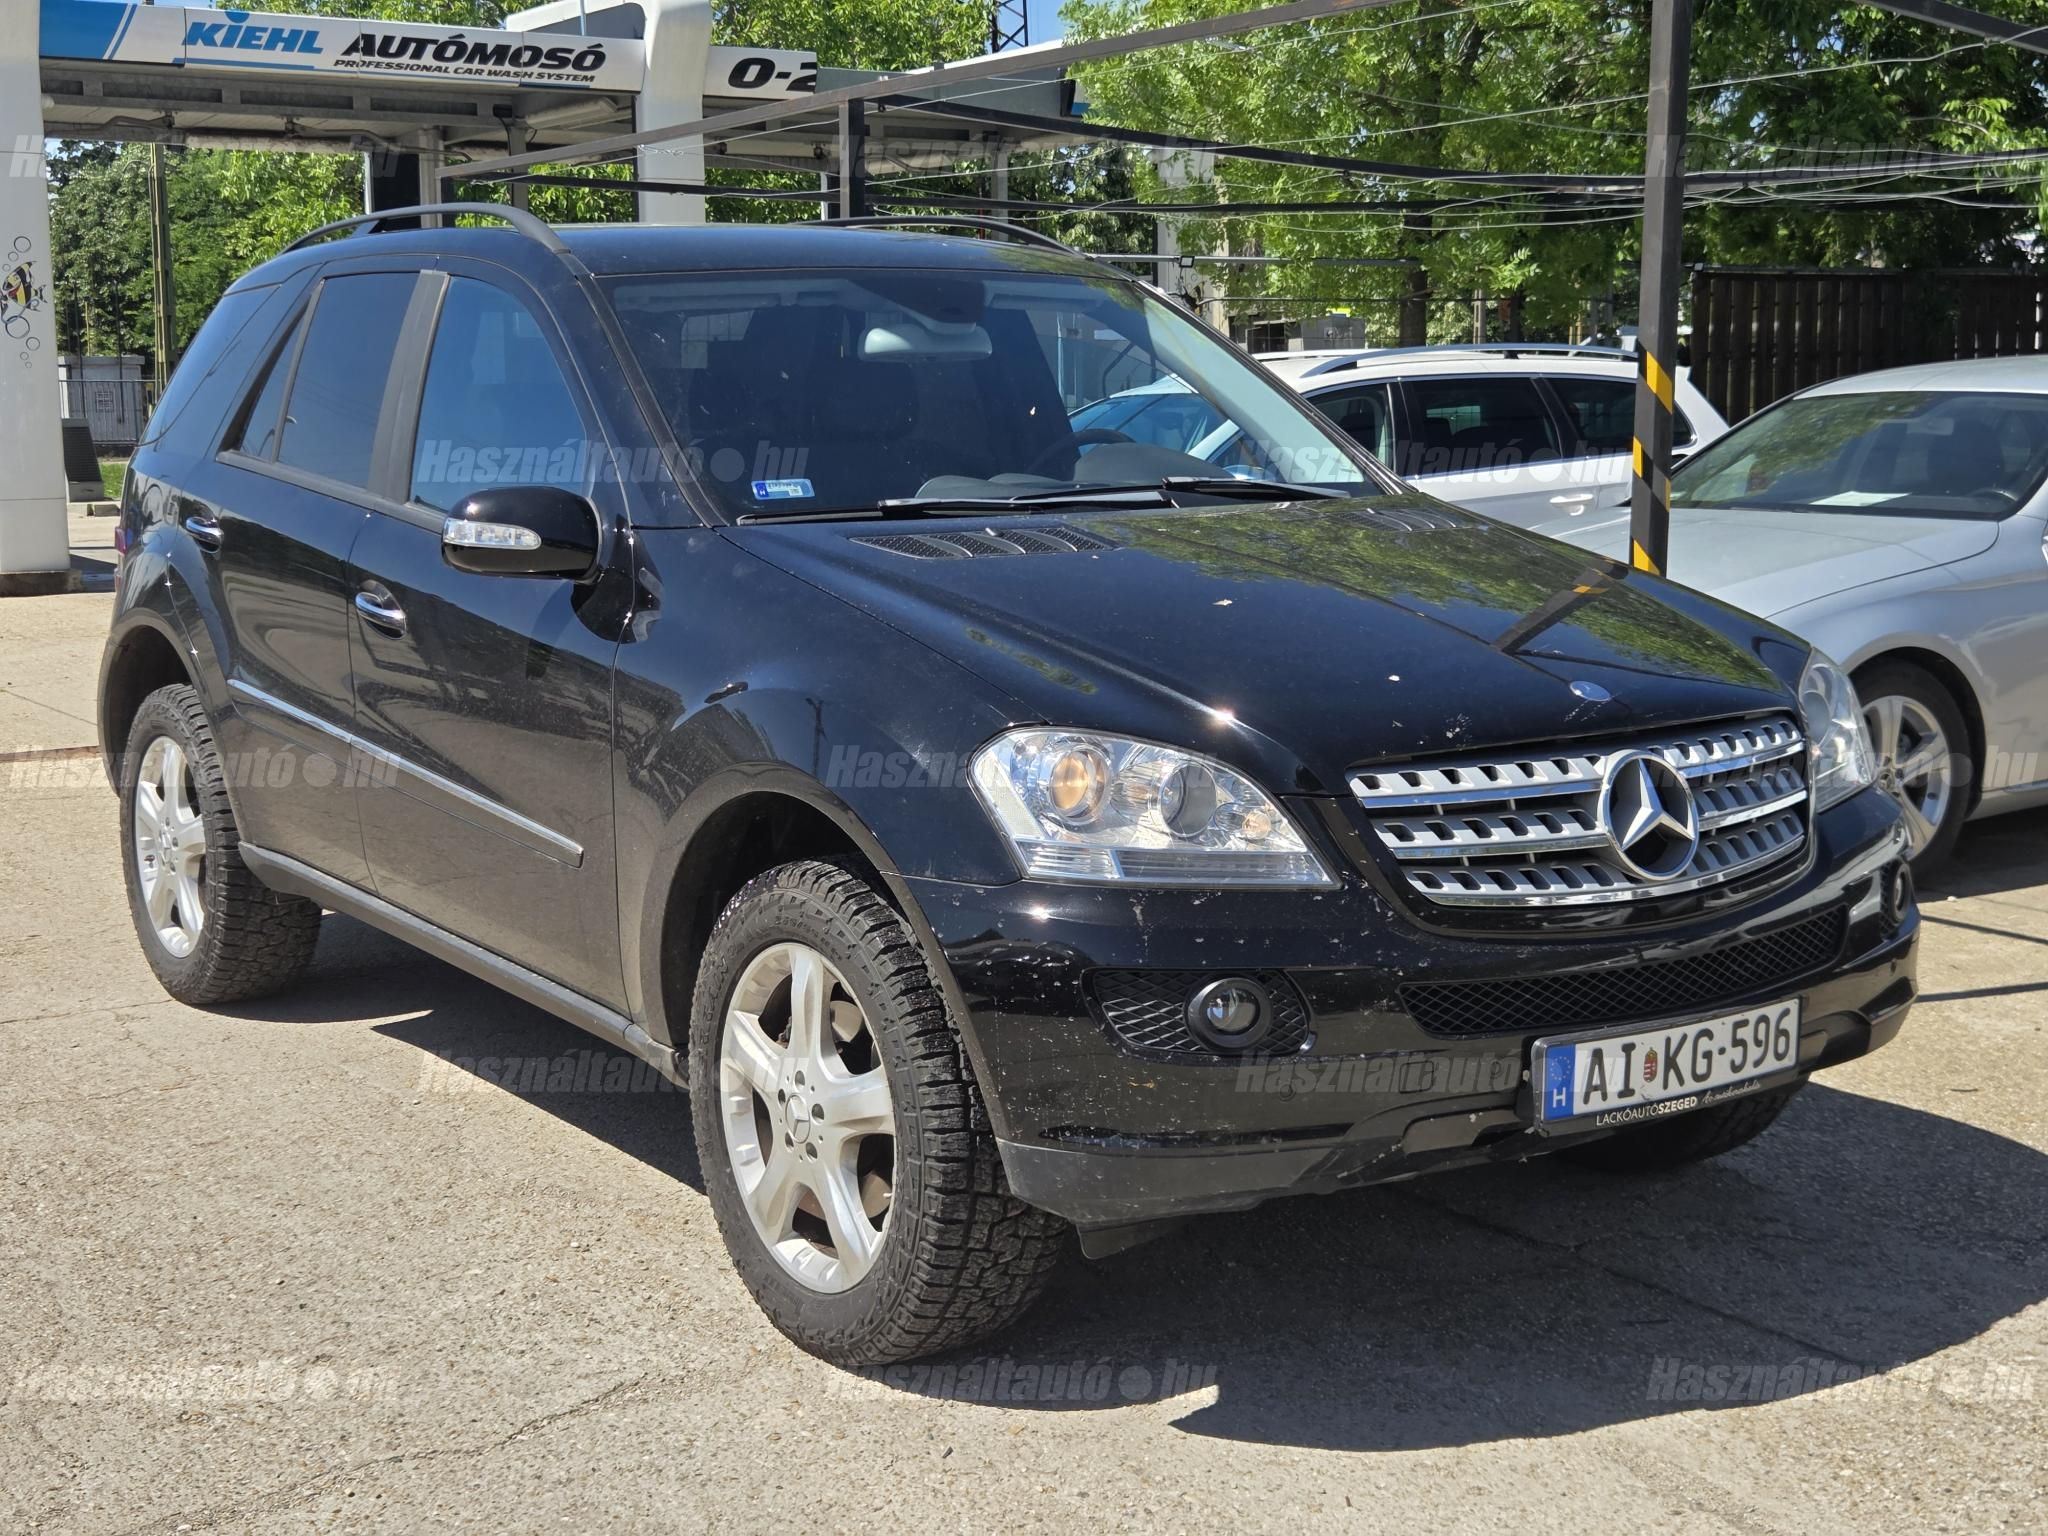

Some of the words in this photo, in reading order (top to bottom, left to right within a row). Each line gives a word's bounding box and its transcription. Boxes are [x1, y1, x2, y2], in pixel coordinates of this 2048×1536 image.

[340, 33, 606, 72] AUTÓMOSÓ
[334, 59, 451, 74] PROFESSIONAL
[453, 67, 485, 76] CAR
[487, 69, 534, 79] WASH
[536, 72, 596, 82] SYSTEM
[1582, 1041, 1637, 1105] AI
[1662, 1007, 1791, 1091] KG-596
[1552, 1087, 1567, 1109] H
